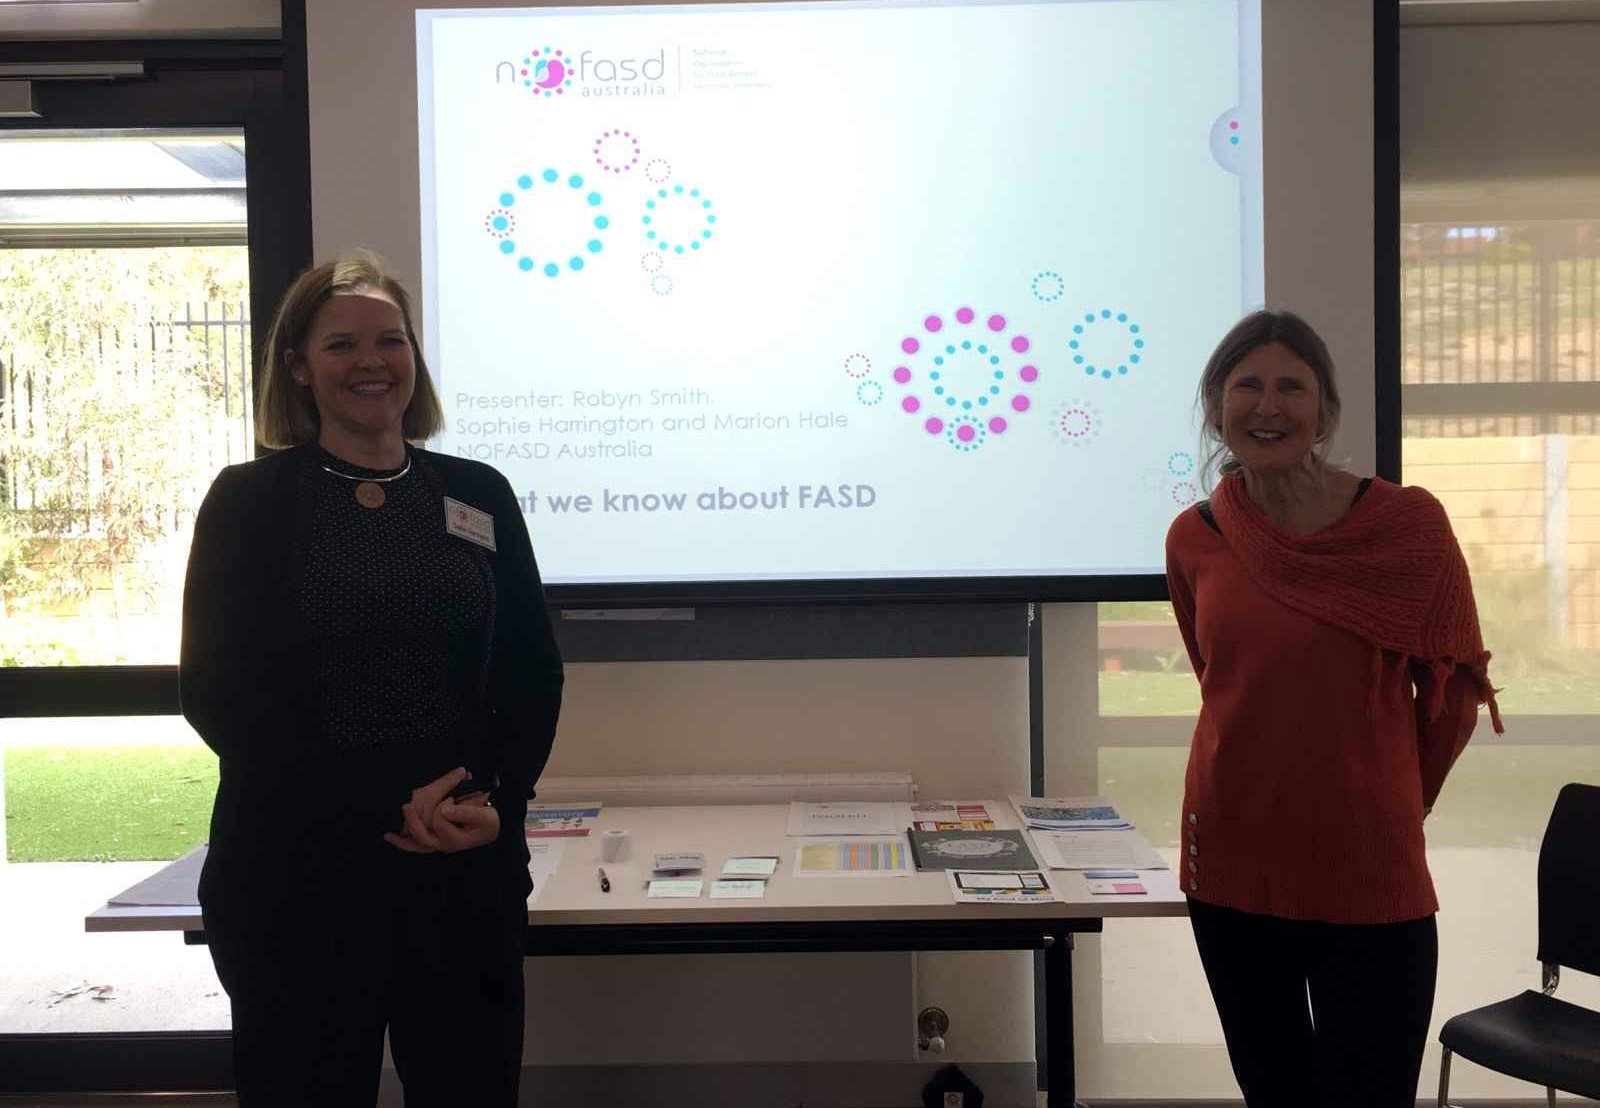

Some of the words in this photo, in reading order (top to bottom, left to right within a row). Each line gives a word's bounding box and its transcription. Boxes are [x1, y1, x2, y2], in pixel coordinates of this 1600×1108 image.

[582, 83, 666, 98] australia
[455, 391, 563, 410] Presenter:
[572, 390, 642, 411] Robyn
[455, 416, 531, 437] Sophie
[538, 414, 654, 436] Harrington
[661, 413, 706, 432] and
[713, 411, 790, 430] Marion
[798, 411, 849, 429] Hale
[456, 442, 550, 460] NOFASD
[557, 440, 653, 459] Australia
[546, 494, 593, 513] we
[603, 488, 687, 512] know
[696, 485, 789, 511] about
[798, 484, 876, 509] FASD
